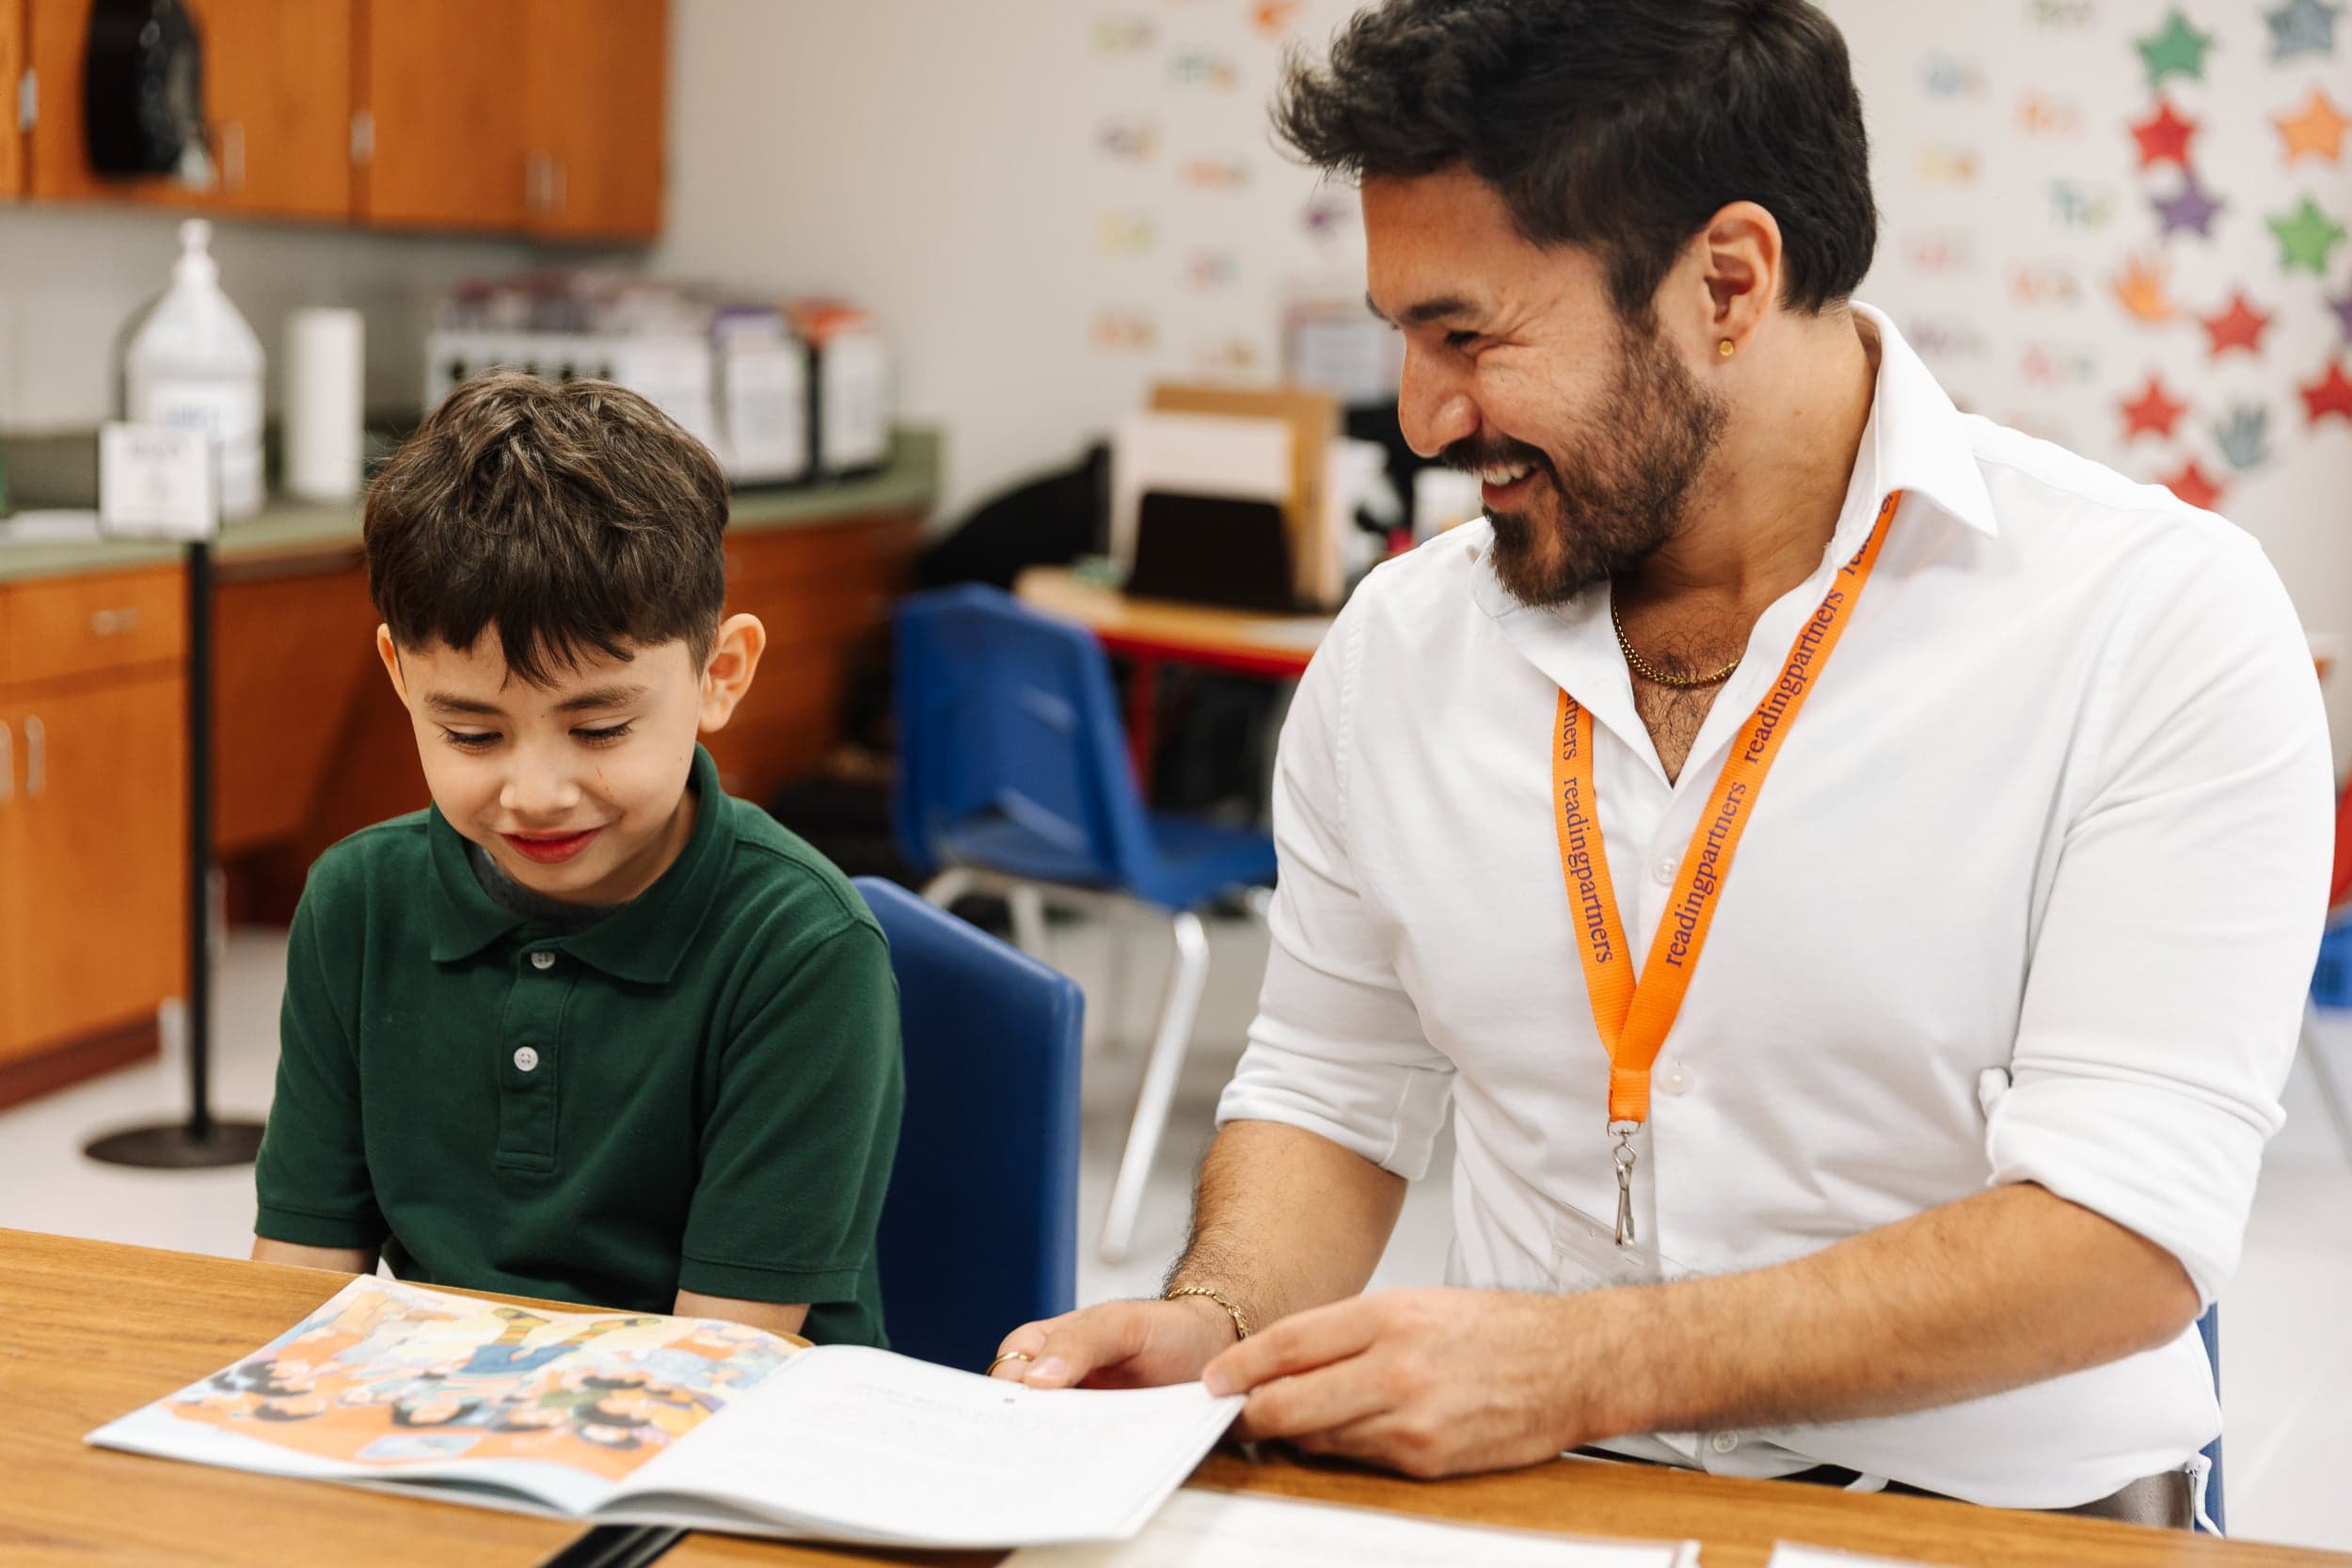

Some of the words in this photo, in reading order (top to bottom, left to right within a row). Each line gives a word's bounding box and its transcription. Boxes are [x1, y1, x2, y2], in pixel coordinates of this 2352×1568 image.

[1744, 589, 1844, 764] readingpartners
[1564, 777, 1613, 963] readingpartners
[1665, 782, 1747, 968] readingpartners
